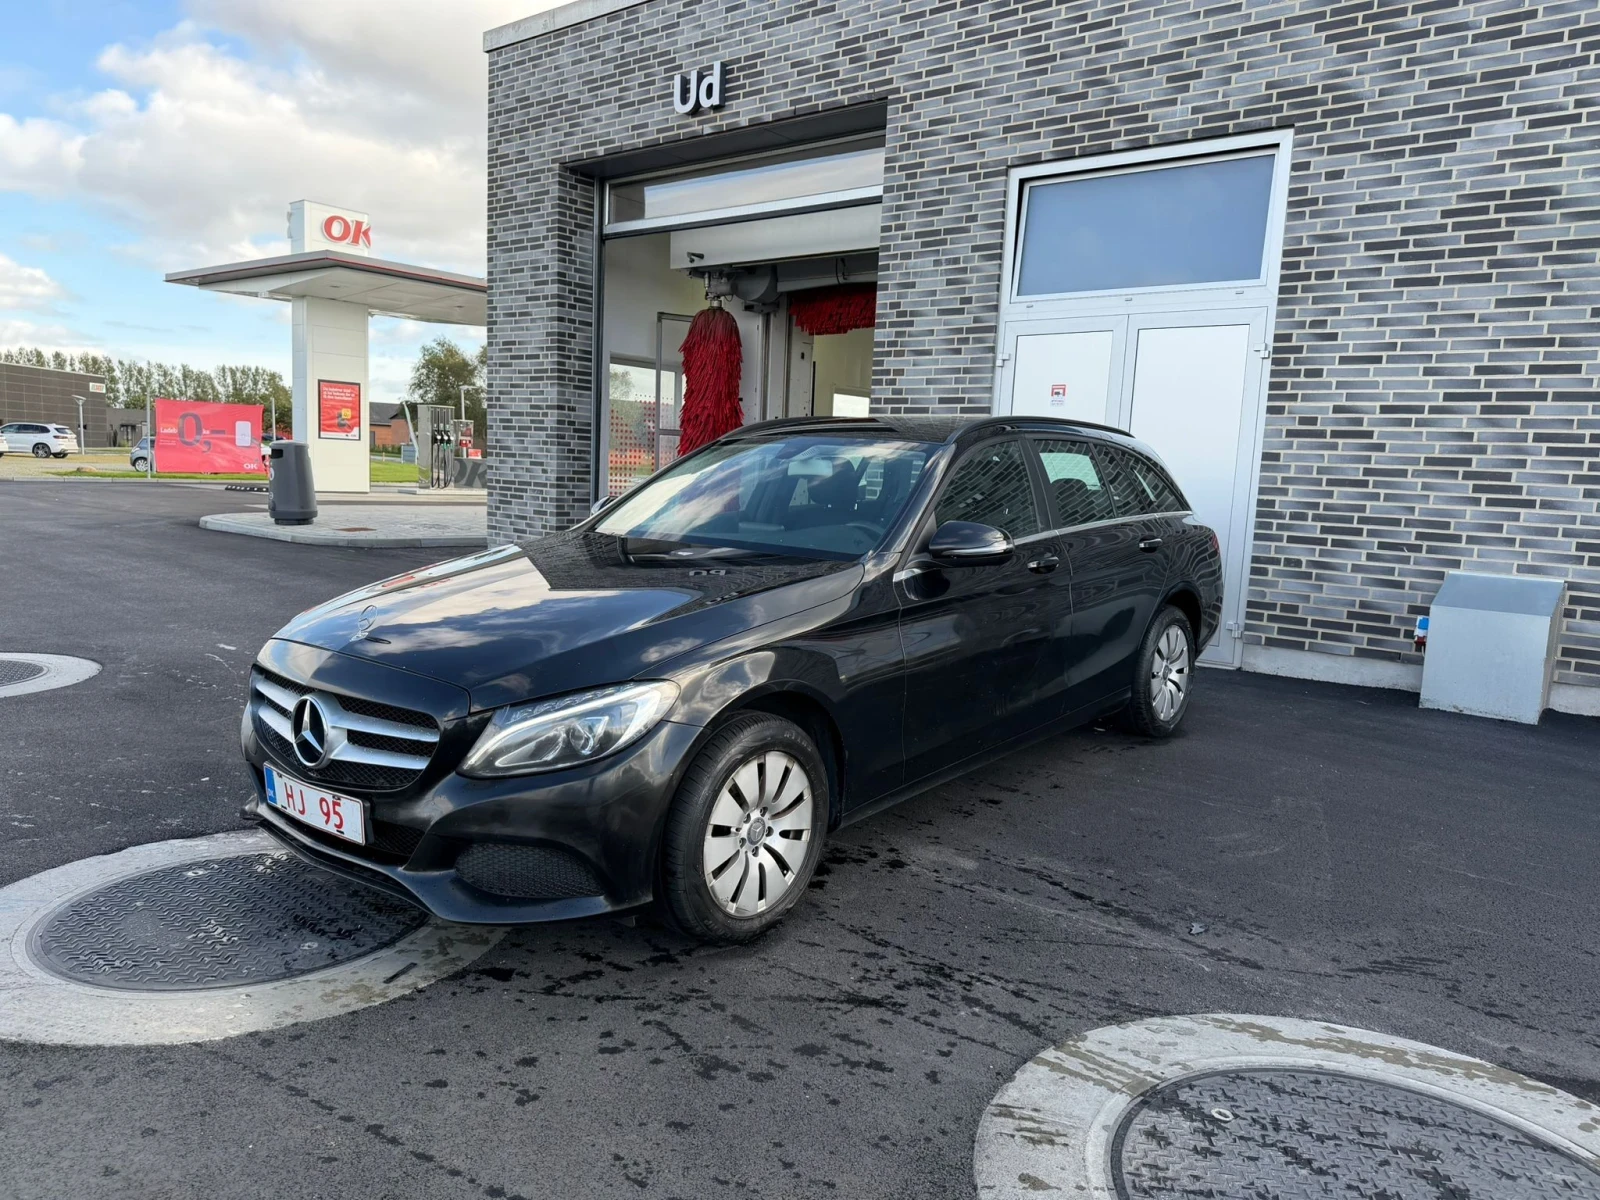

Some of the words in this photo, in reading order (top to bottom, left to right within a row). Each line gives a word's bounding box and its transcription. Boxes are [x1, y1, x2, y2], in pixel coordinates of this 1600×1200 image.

[674, 61, 721, 114] Ud
[322, 214, 372, 248] OK
[243, 462, 258, 470] OK
[284, 780, 306, 816] HJ
[319, 796, 344, 830] 95
